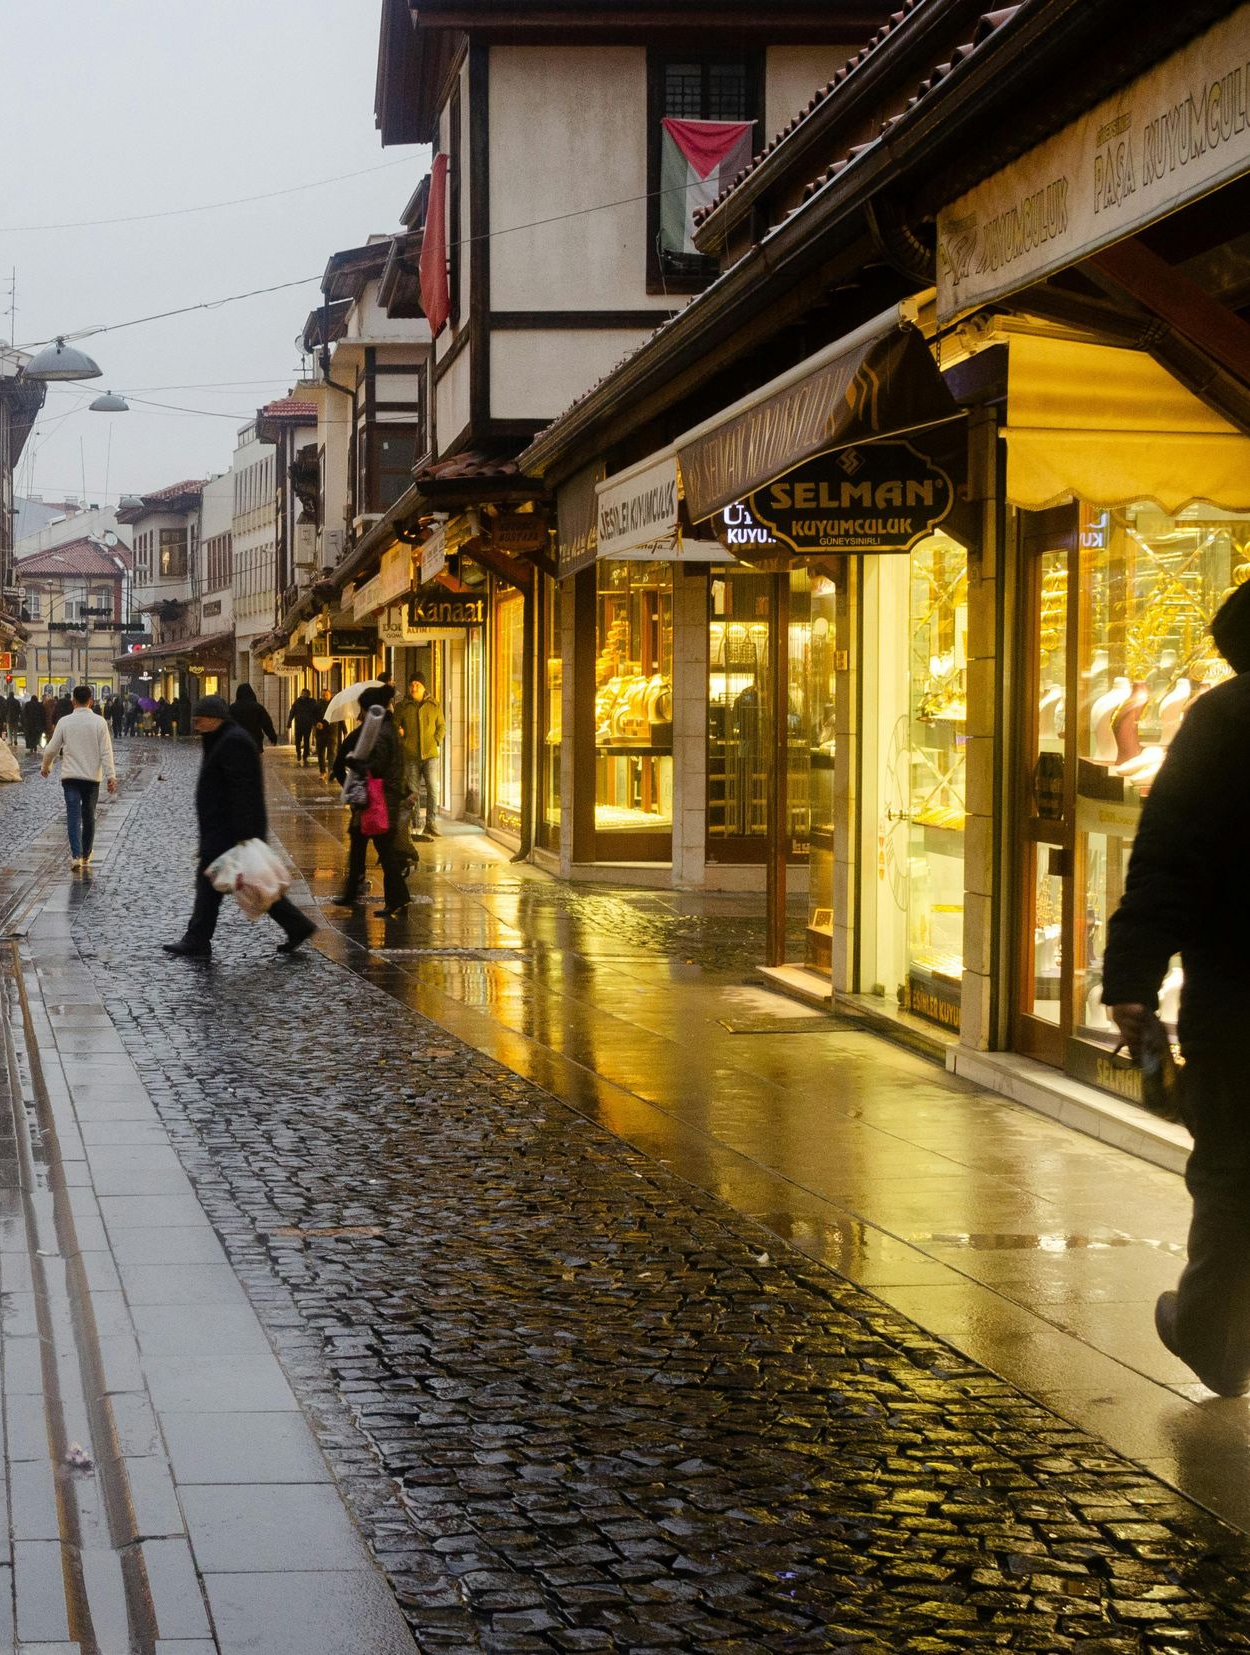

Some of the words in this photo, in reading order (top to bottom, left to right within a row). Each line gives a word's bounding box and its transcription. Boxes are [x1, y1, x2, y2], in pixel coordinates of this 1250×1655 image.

[1094, 130, 1136, 215] PAŞA
[770, 480, 934, 510] SELMAN
[792, 518, 913, 537] KUYUMCULUK
[414, 600, 485, 623] Kanaat
